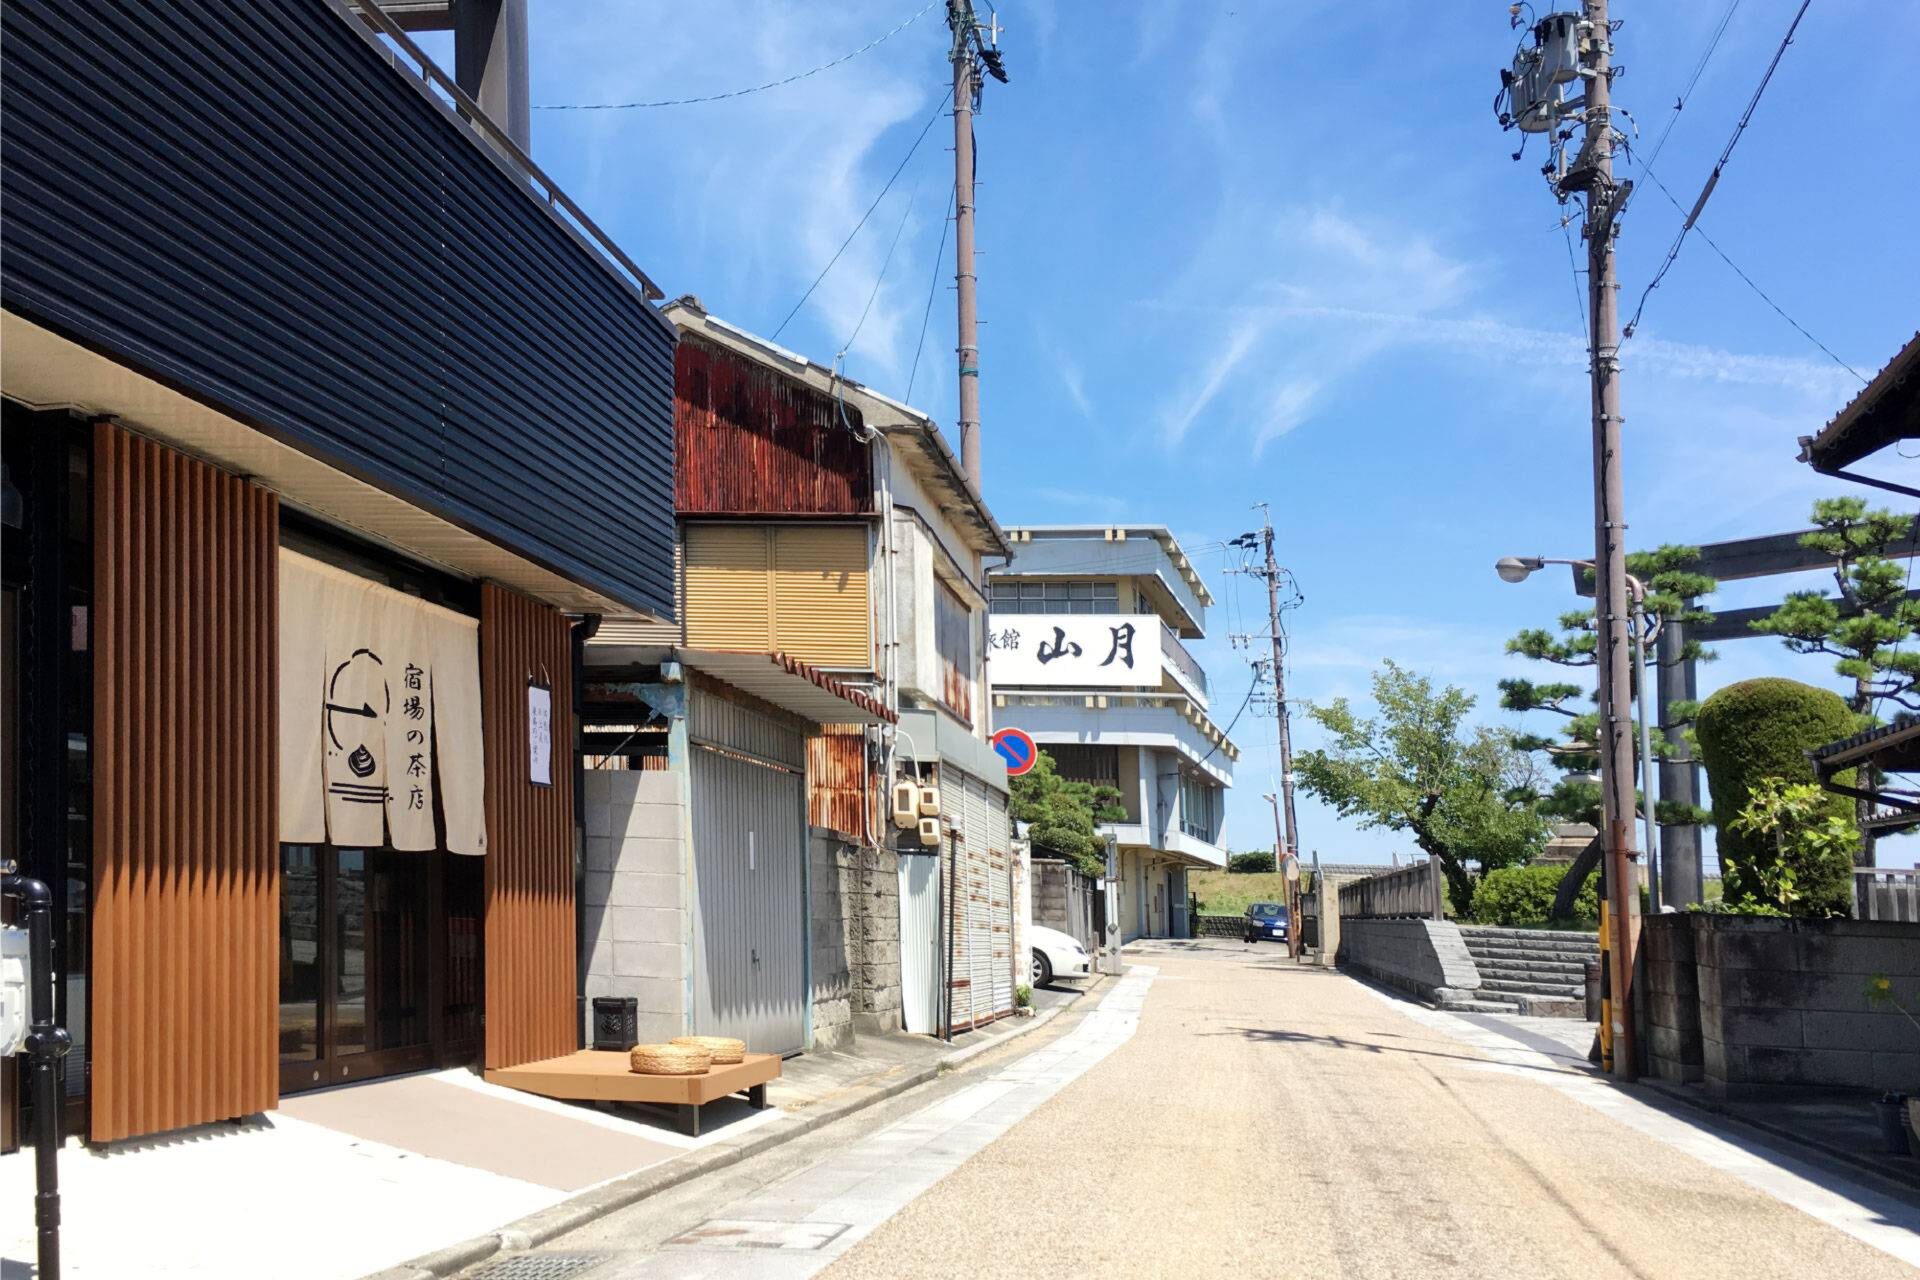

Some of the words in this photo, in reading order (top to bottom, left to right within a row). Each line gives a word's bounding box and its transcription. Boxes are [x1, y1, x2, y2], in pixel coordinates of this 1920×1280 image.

[1036, 622, 1136, 669] 山月
[403, 663, 427, 811] 宿場の茶店
